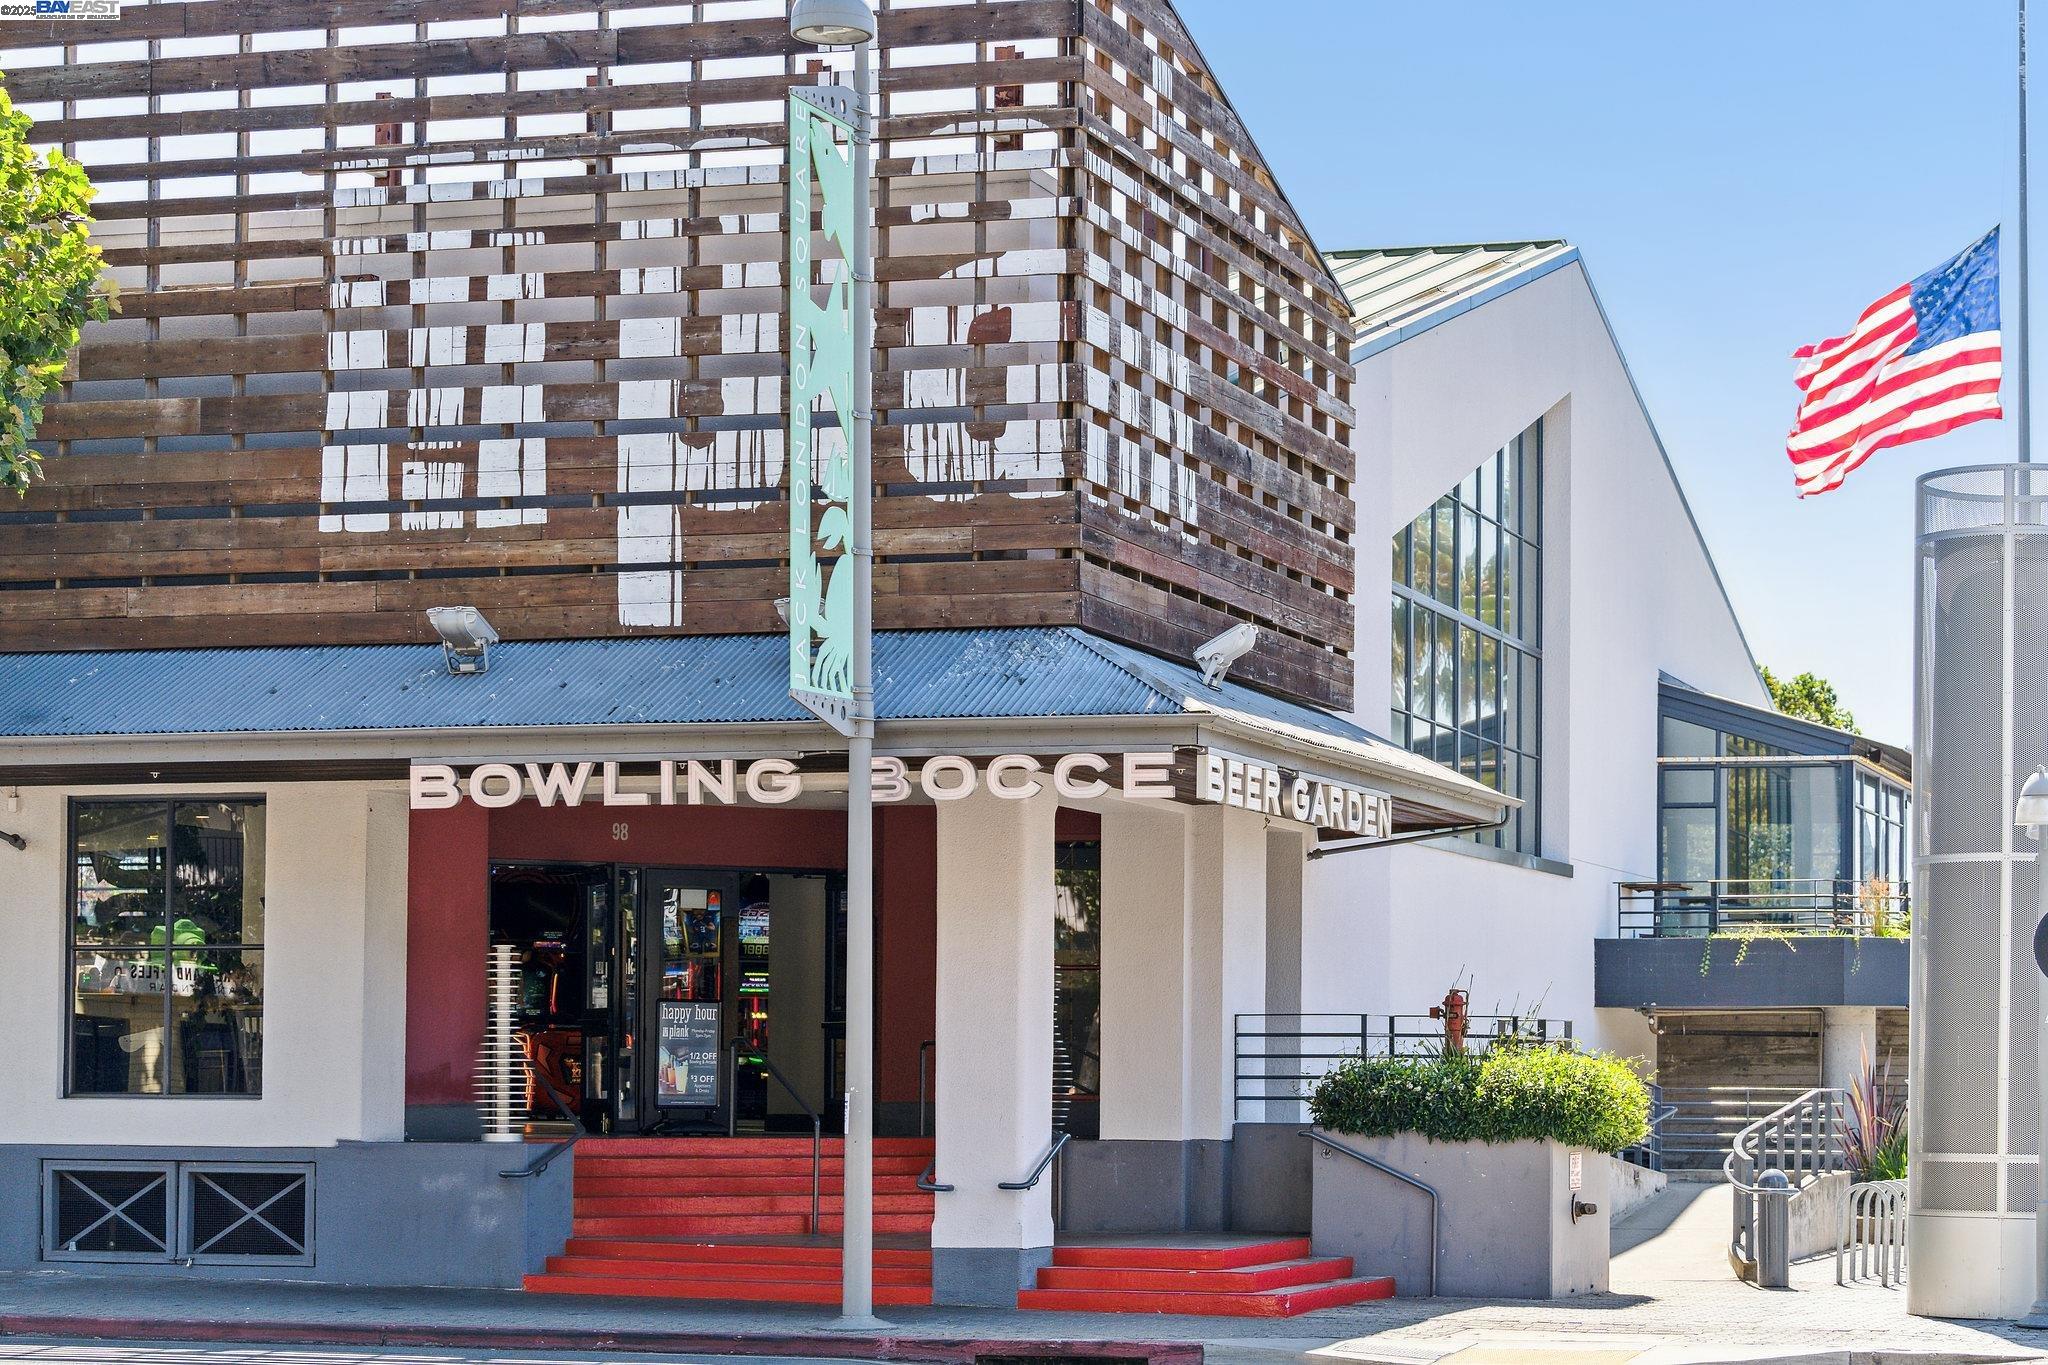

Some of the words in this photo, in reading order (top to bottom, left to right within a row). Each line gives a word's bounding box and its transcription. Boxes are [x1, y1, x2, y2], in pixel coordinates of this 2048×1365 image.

[795, 104, 807, 293] SQUARE
[795, 324, 807, 536] LONDON
[795, 568, 807, 684] JACK
[410, 758, 803, 810] BOWLING
[871, 752, 1176, 802] BOCCE
[1196, 753, 1282, 816] BEER
[1284, 776, 1392, 839] GARDEN
[612, 822, 629, 840] 98
[662, 1003, 692, 1024] happy
[694, 1004, 718, 1021] hour
[669, 1025, 690, 1040] plank
[689, 1052, 701, 1060] 1/2
[702, 1052, 718, 1060] OFF
[690, 1075, 698, 1083] $3
[699, 1075, 715, 1083] OFF
